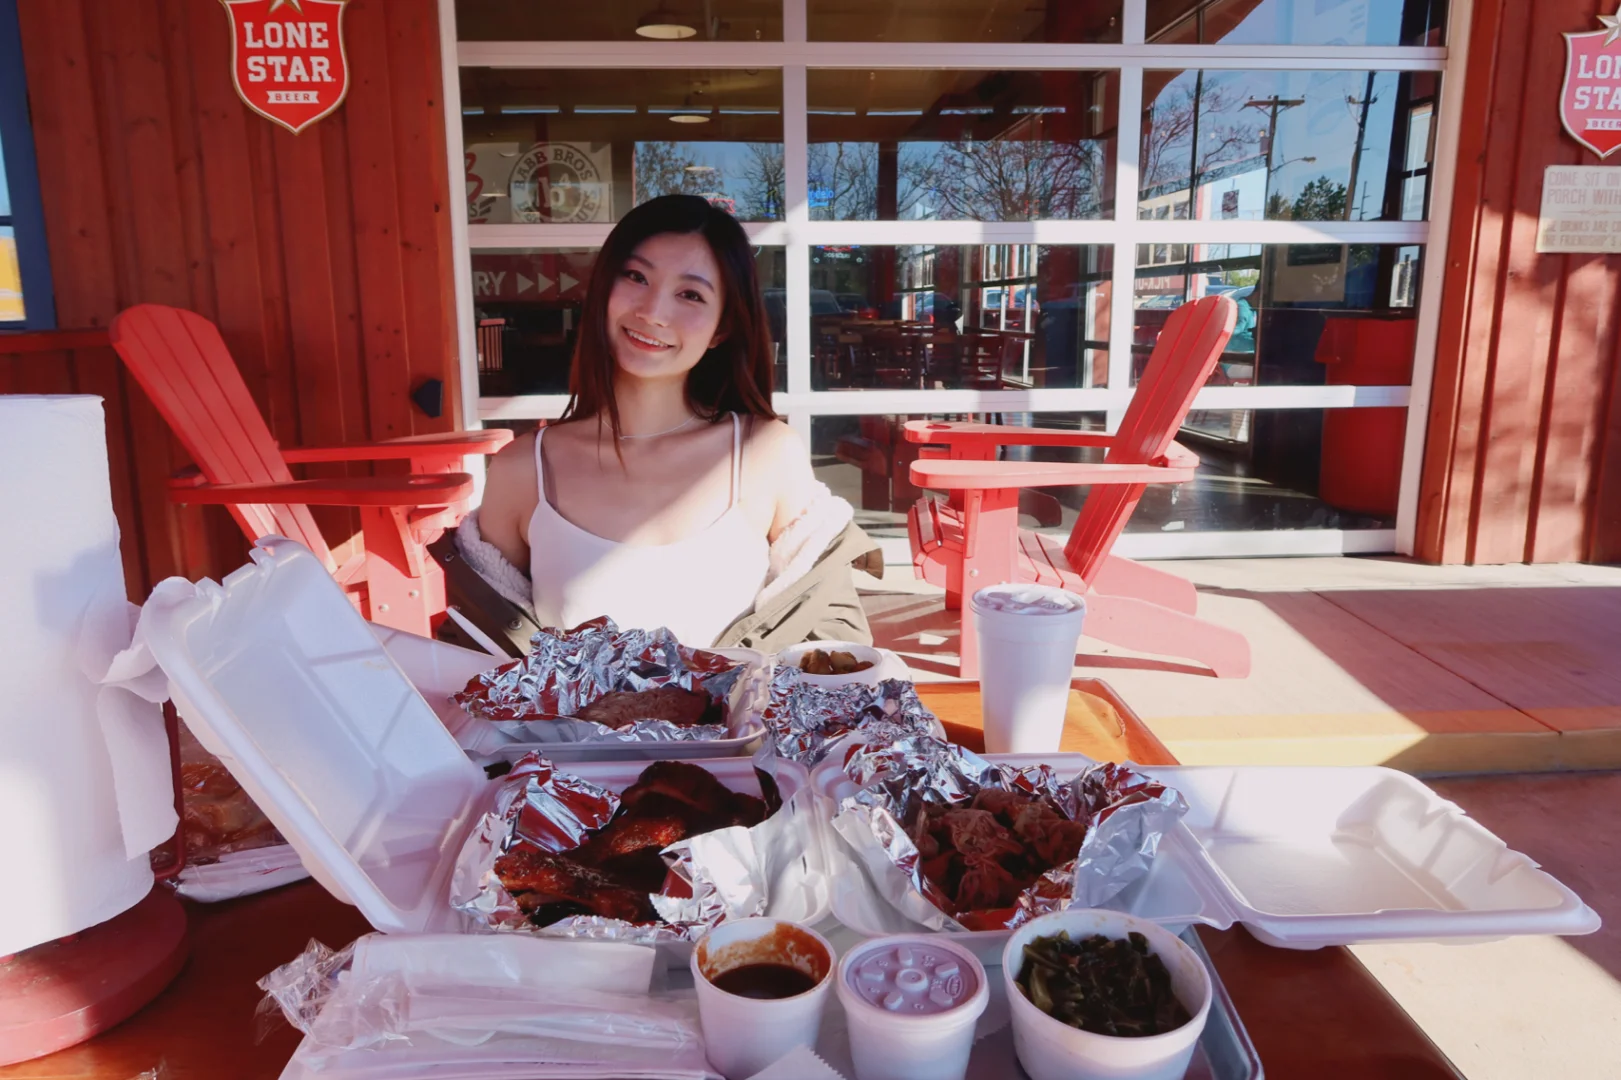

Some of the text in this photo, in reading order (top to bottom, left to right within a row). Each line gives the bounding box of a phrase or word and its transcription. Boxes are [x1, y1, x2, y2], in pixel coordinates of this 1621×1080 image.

[243, 22, 329, 48] LONE
[247, 56, 333, 82] STAR
[275, 93, 310, 101] BEER
[513, 148, 592, 191] BABB BROS
[1584, 172, 1601, 187] SIT
[1546, 189, 1587, 204] PORCH
